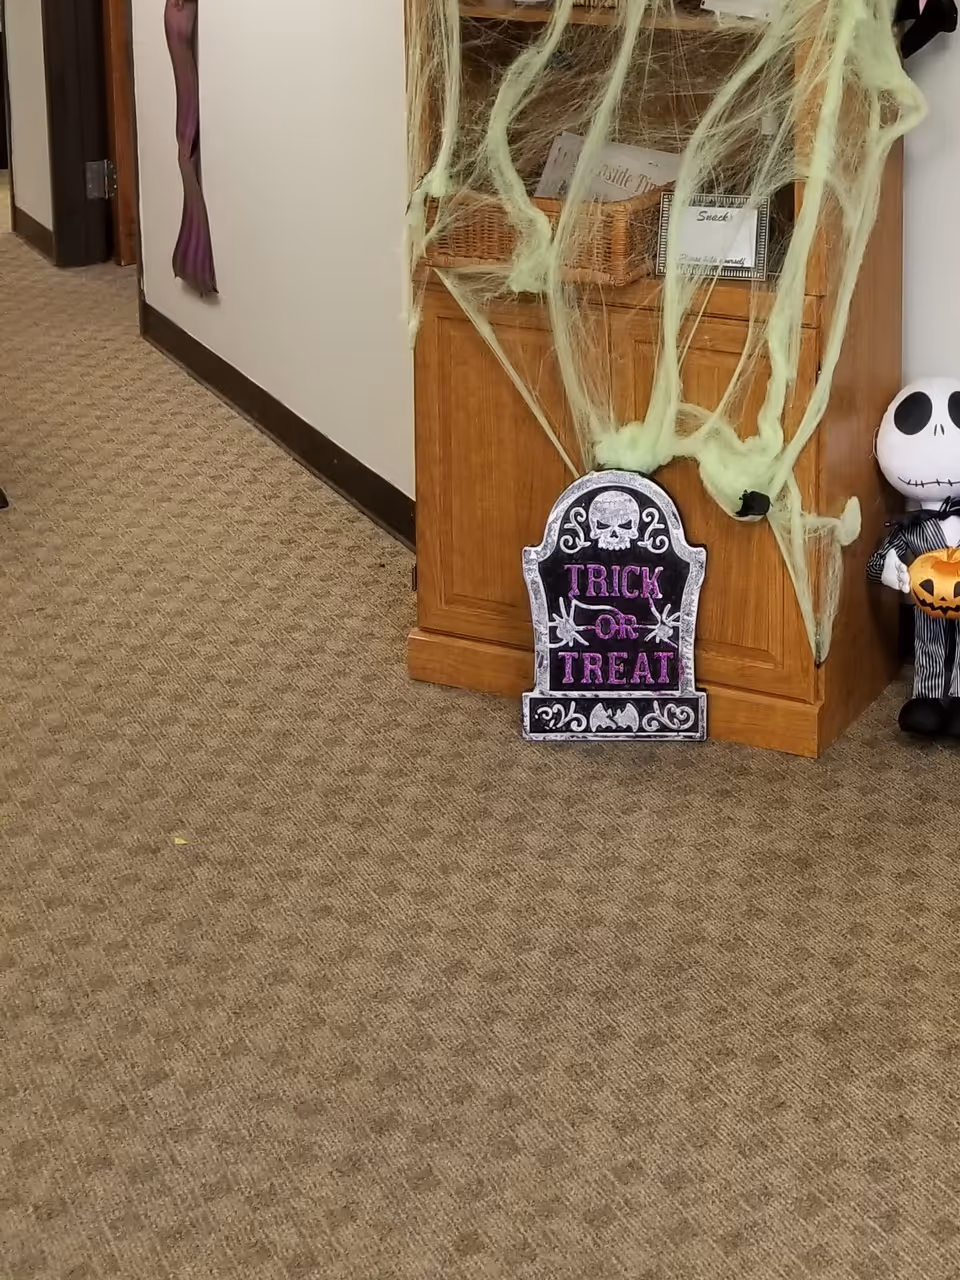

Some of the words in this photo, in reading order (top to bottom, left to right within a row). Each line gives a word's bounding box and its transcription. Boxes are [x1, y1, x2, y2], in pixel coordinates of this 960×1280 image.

[564, 564, 664, 599] TRICK
[595, 614, 639, 640] OR
[558, 651, 674, 685] TREAT
